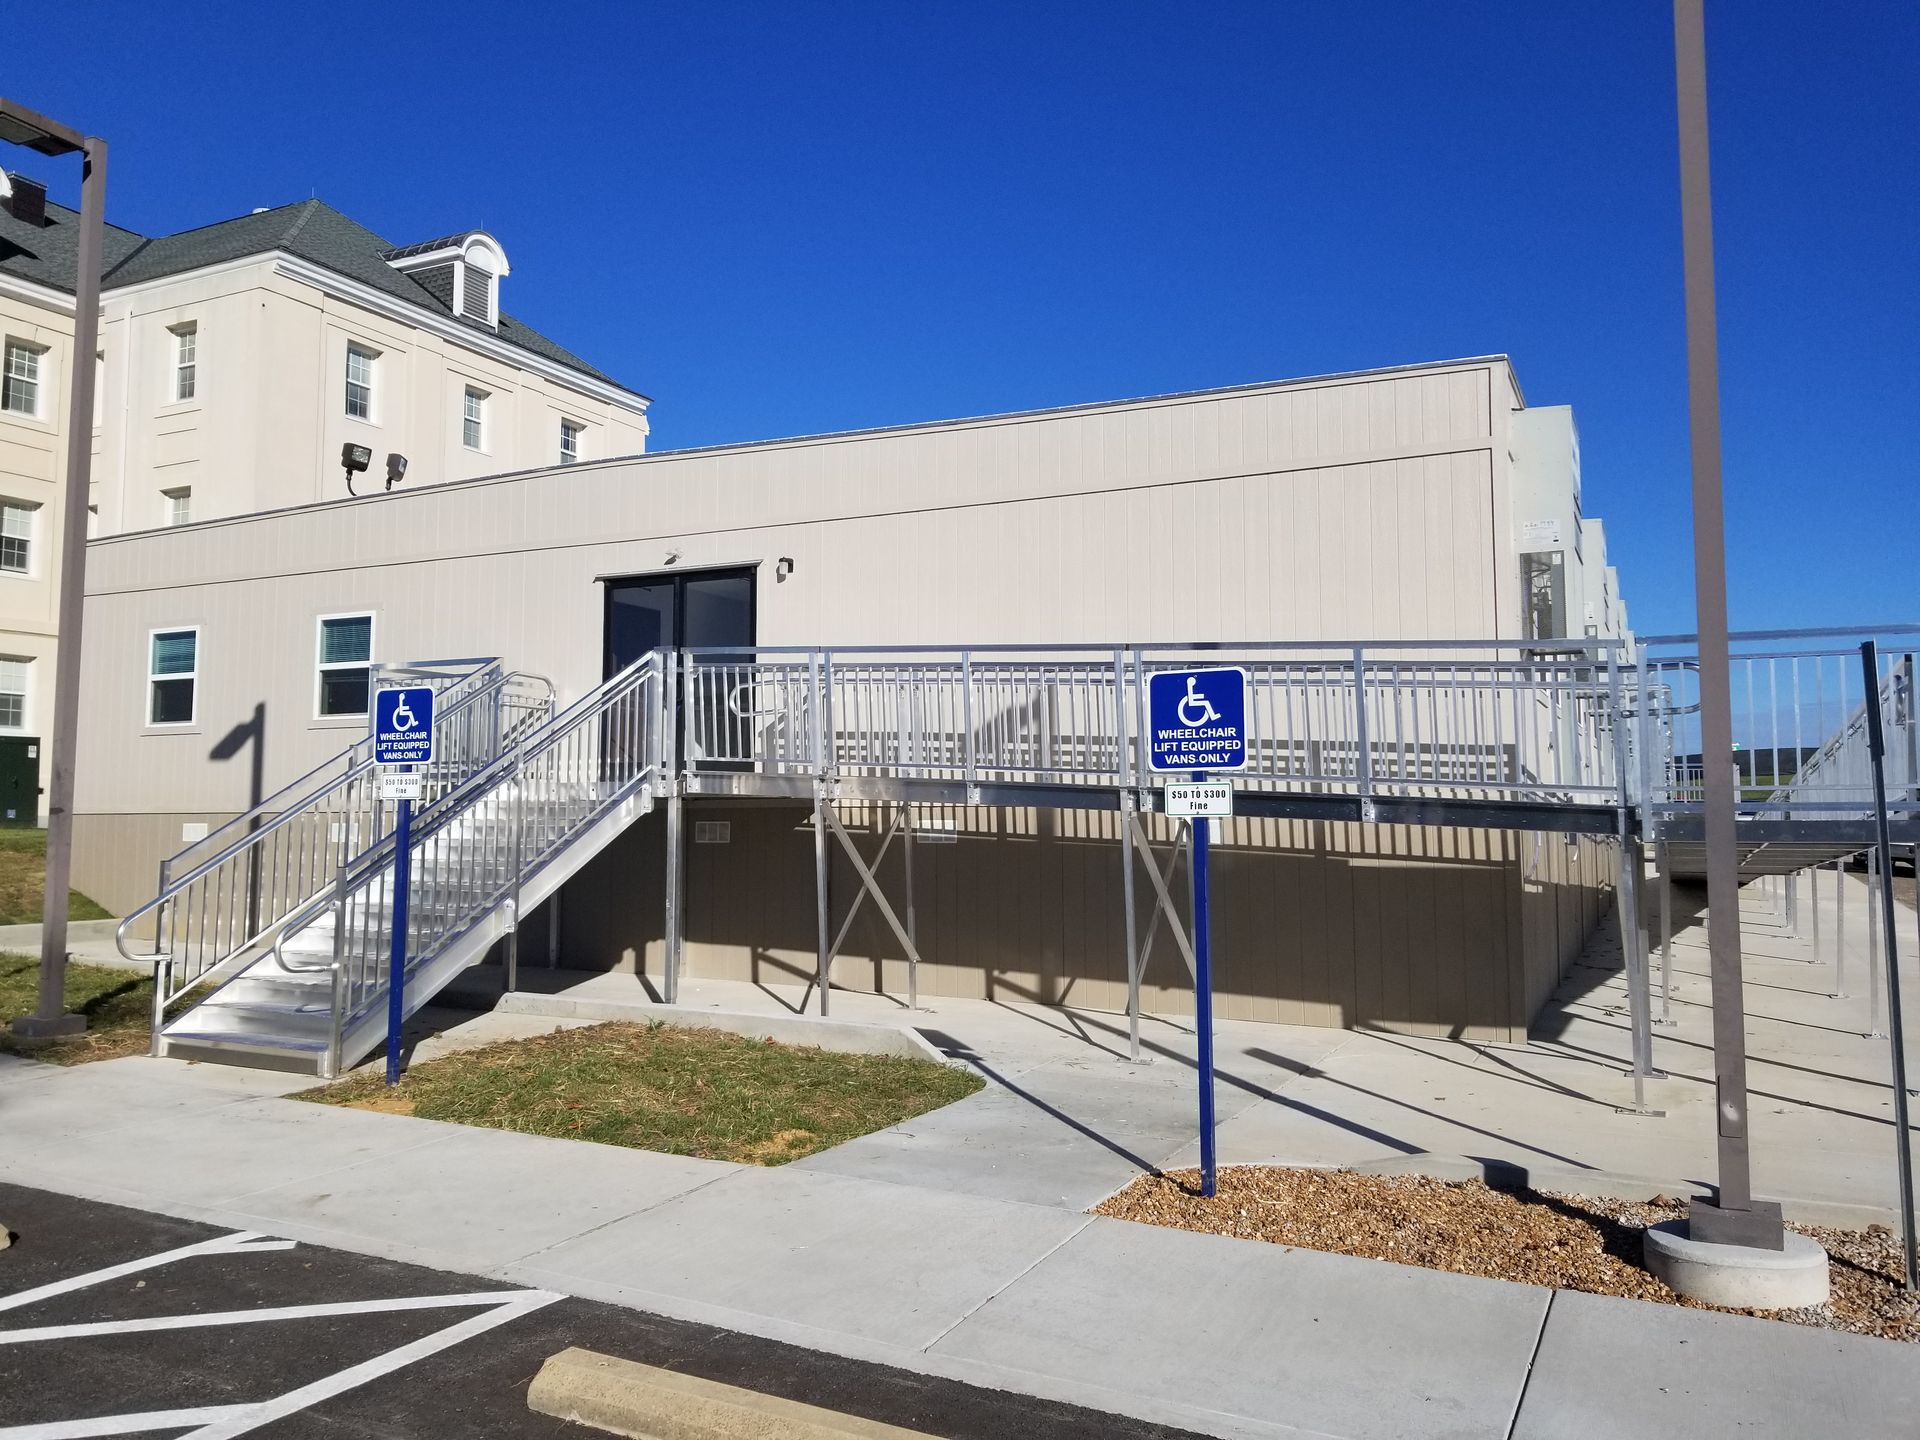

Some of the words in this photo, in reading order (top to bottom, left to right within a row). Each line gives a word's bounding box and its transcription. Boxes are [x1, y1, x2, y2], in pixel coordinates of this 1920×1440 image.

[380, 732, 427, 740] WHEELCHAIR
[1158, 727, 1236, 739] WHEELCHAIR
[393, 742, 430, 750] EQUIPPED
[1154, 742, 1178, 752] LIFT
[1181, 740, 1241, 752] EQUIPPED
[383, 752, 402, 760] VANS
[404, 751, 423, 759] ONLY
[1165, 754, 1196, 764] VANS
[1199, 753, 1231, 763] ONLY
[1171, 790, 1188, 799] $50
[1191, 790, 1201, 798] TO
[1204, 789, 1226, 799] $300
[1190, 801, 1208, 810] Fine
